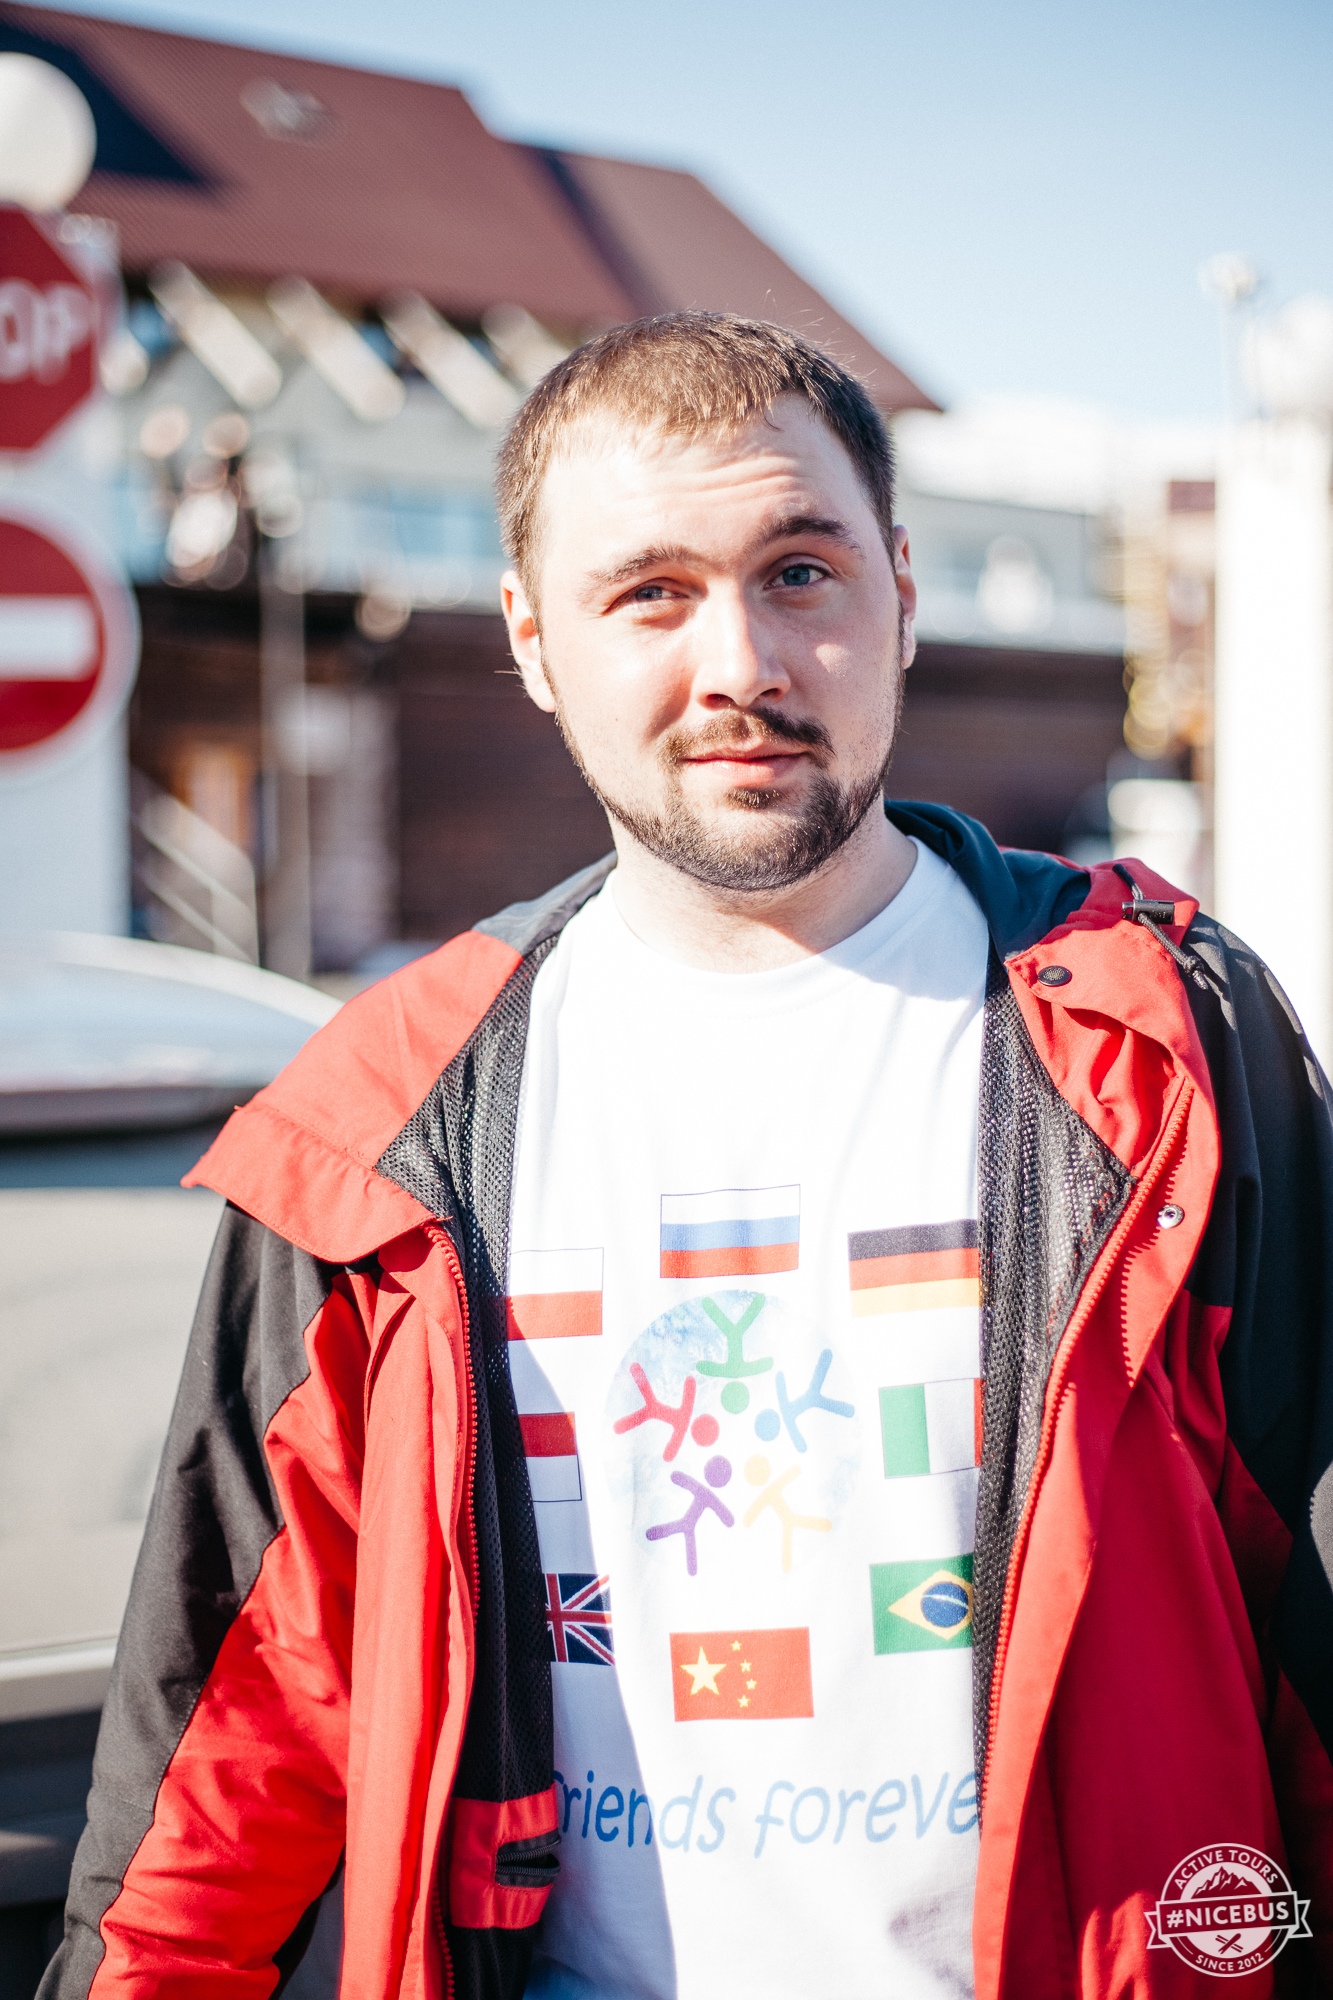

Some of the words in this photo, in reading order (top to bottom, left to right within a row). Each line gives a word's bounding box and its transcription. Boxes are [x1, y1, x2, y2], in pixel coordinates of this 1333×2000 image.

[0, 278, 89, 384] OP
[553, 1769, 737, 1854] riends
[754, 1770, 981, 1859] foreve
